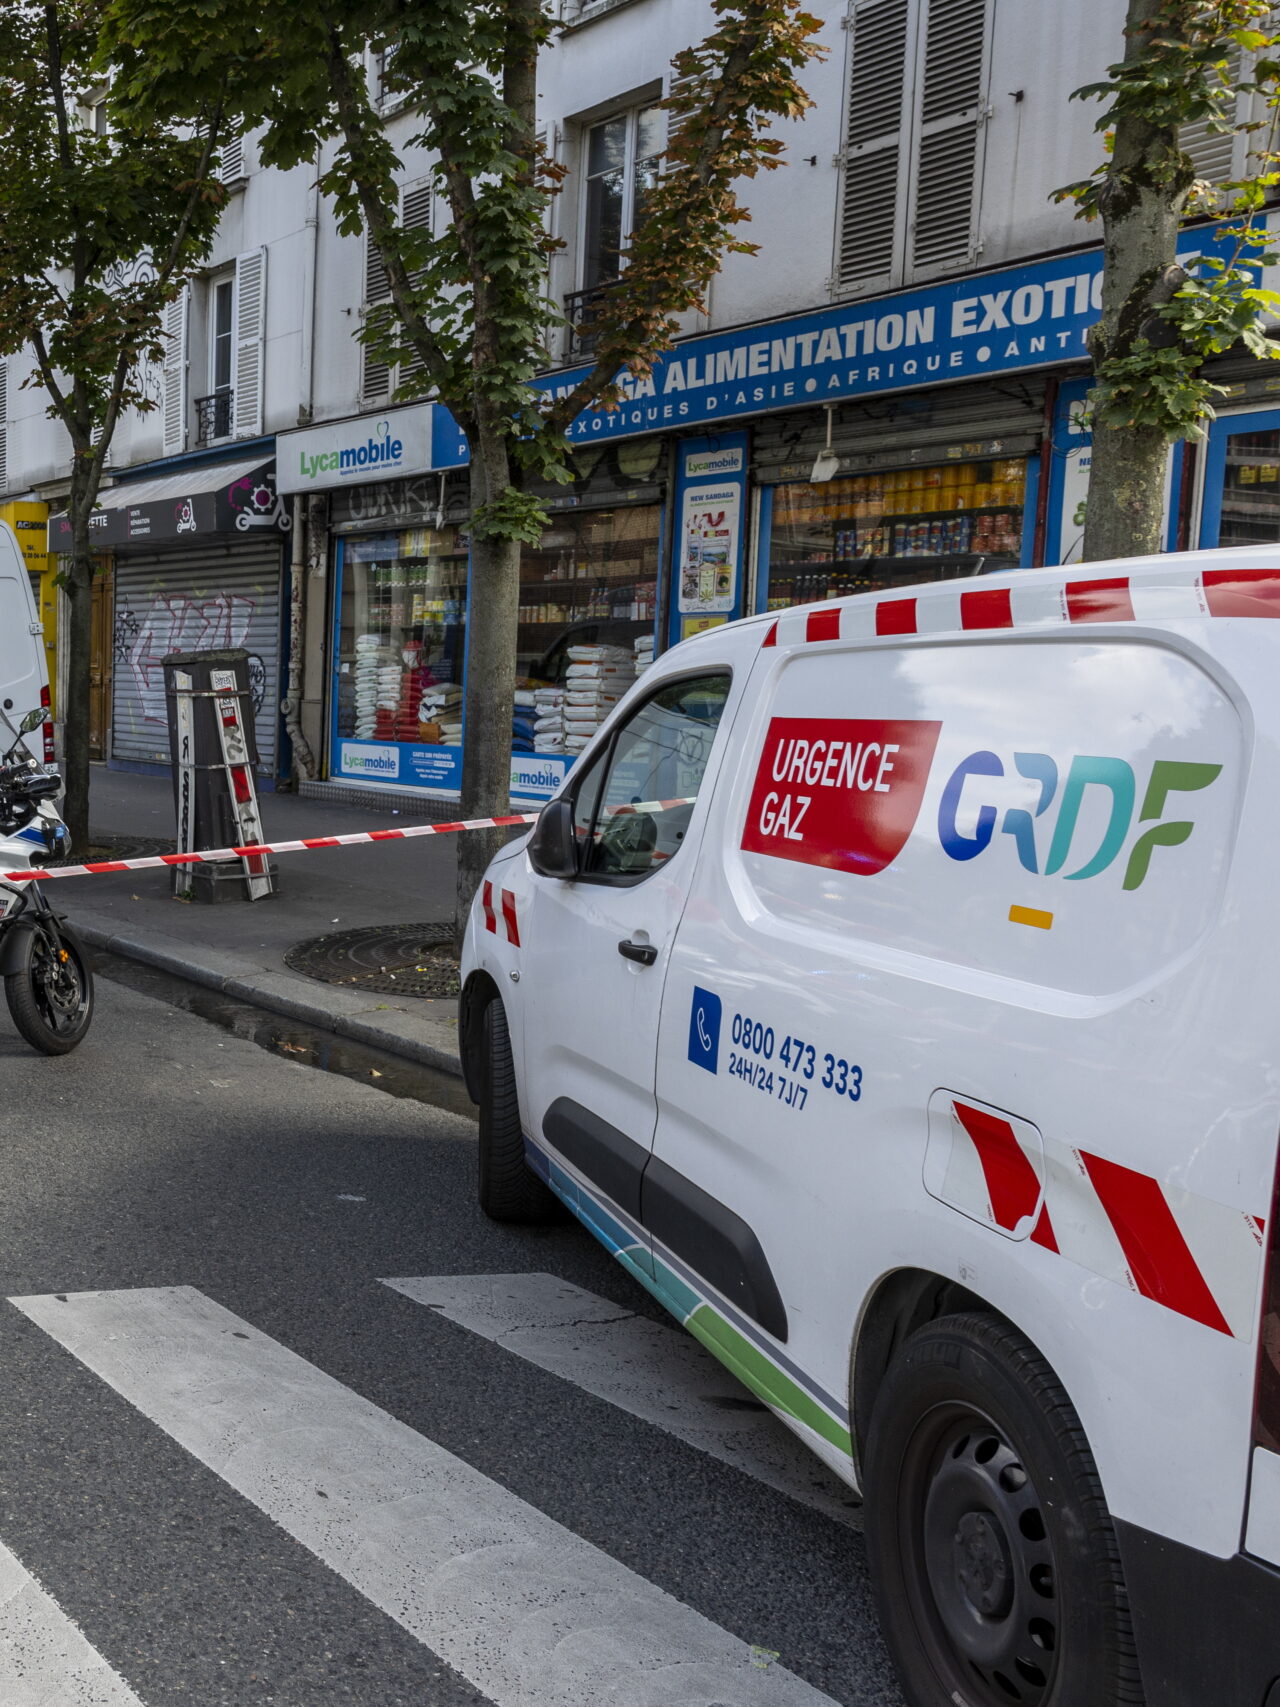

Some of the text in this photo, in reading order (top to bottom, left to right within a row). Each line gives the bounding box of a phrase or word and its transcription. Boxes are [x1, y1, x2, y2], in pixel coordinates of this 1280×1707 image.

[663, 306, 935, 394] ALIMENTATION
[707, 382, 794, 410] D'ASIE
[828, 351, 963, 389] AFRIQUE
[300, 435, 403, 479] Lycamobile
[688, 457, 740, 472] Lycamobile
[1080, 458, 1091, 466] NE
[344, 752, 396, 770] Lycamobile
[511, 770, 560, 787] amobile
[772, 739, 900, 792] URGENCE
[759, 791, 811, 841] GAZ
[938, 750, 1223, 891] GRDF
[728, 1052, 808, 1111] 24H/24 7J/7
[732, 1013, 863, 1102] 0800 473 333
